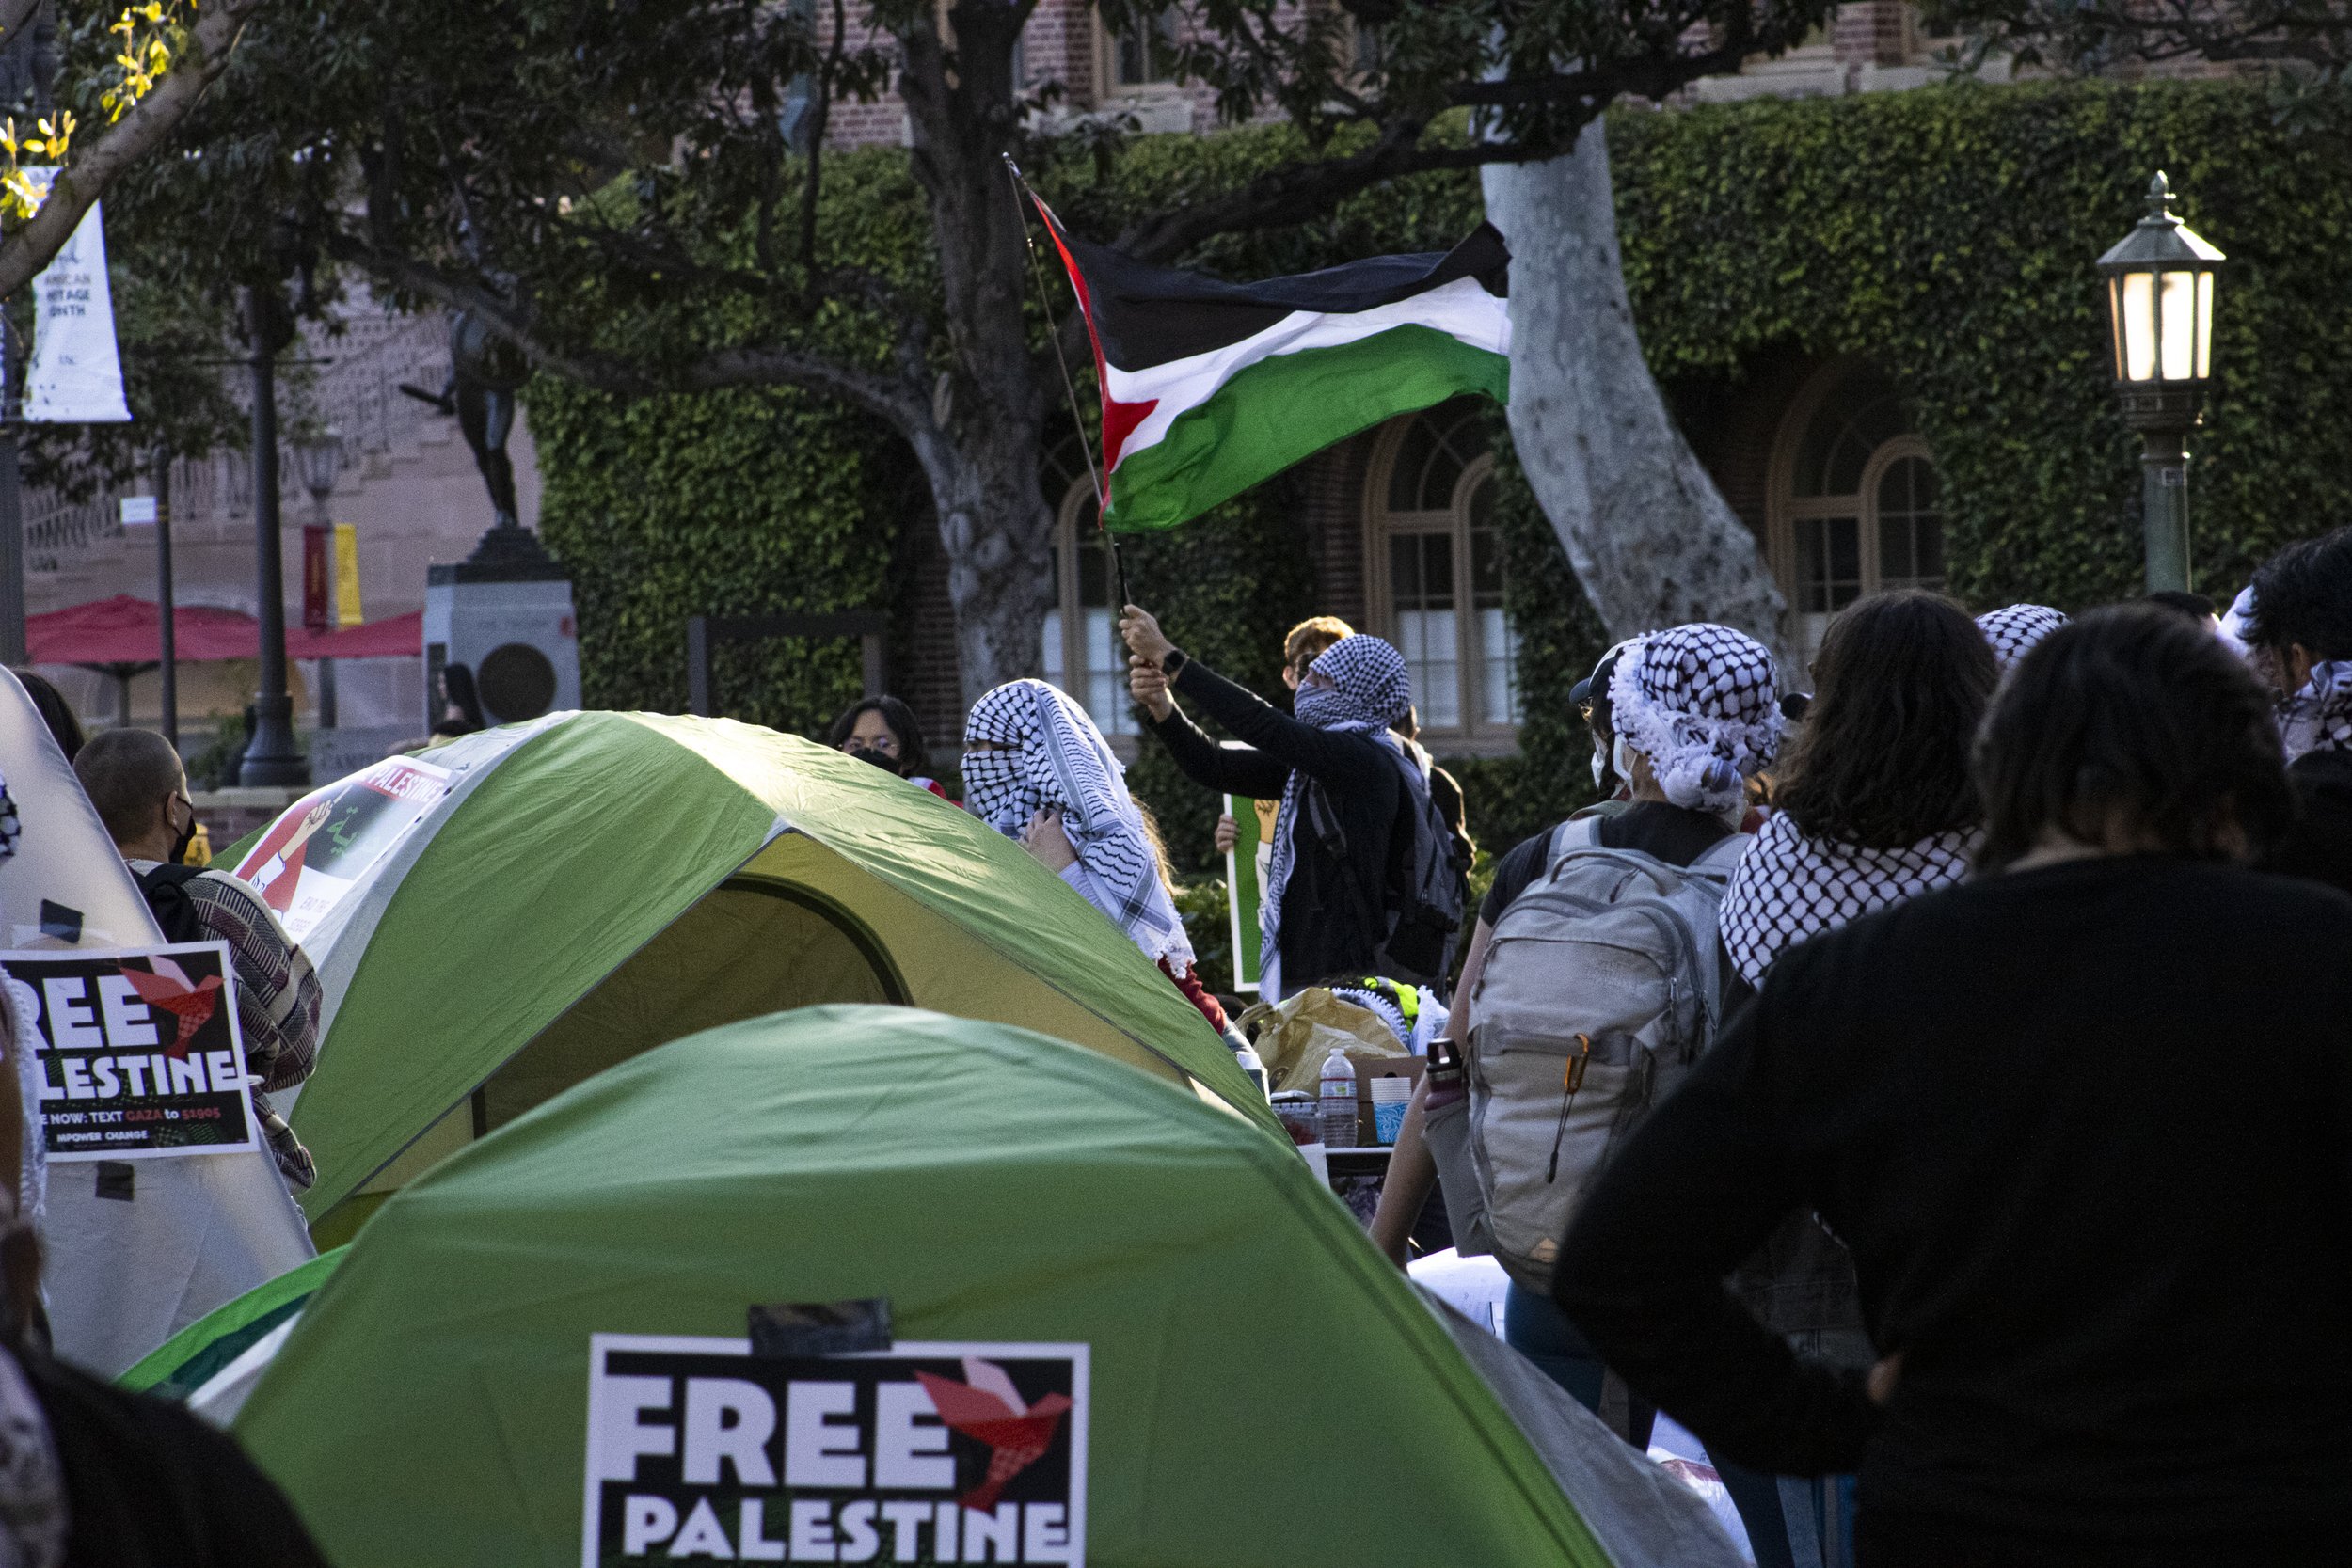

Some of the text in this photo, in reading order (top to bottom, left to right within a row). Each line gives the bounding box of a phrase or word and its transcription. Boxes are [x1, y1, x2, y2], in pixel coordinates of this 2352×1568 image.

[368, 767, 445, 802] PALESTINE
[38, 1050, 239, 1101] LESTINE
[50, 1113, 88, 1125] NOW:
[88, 1111, 123, 1123] TEXT
[125, 1109, 163, 1122] GAZA
[164, 1108, 179, 1120] to
[56, 1130, 148, 1143] MPOWER CHANGE
[599, 1375, 956, 1489] FREE
[623, 1495, 1070, 1563] PALESTINE
